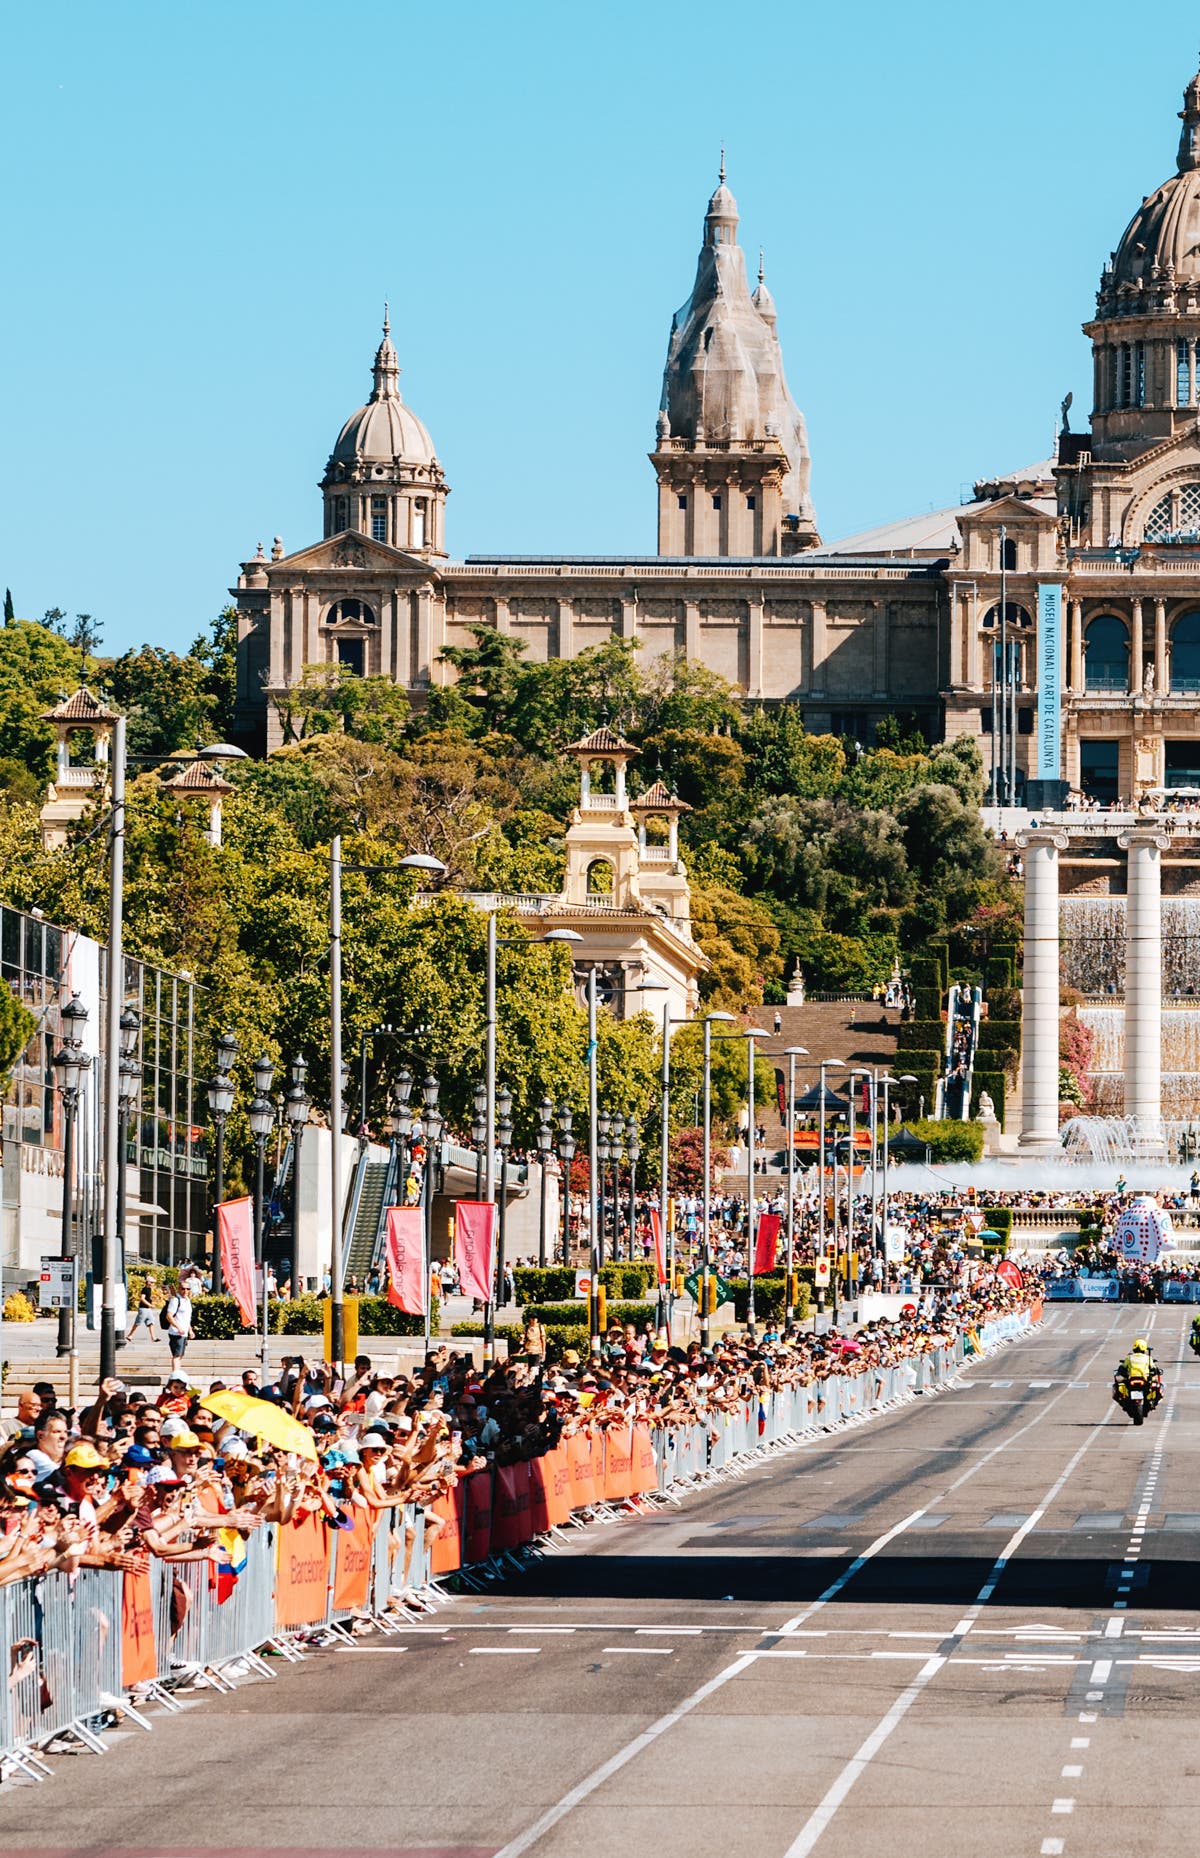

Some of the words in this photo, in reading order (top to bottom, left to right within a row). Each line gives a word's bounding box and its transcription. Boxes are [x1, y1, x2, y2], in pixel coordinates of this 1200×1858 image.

[1045, 594, 1056, 624] MUSEU
[1044, 627, 1055, 671] NACIONAL
[1044, 675, 1055, 701] D'ART
[1044, 704, 1055, 715] DE
[1043, 718, 1055, 769] CATALUNYA
